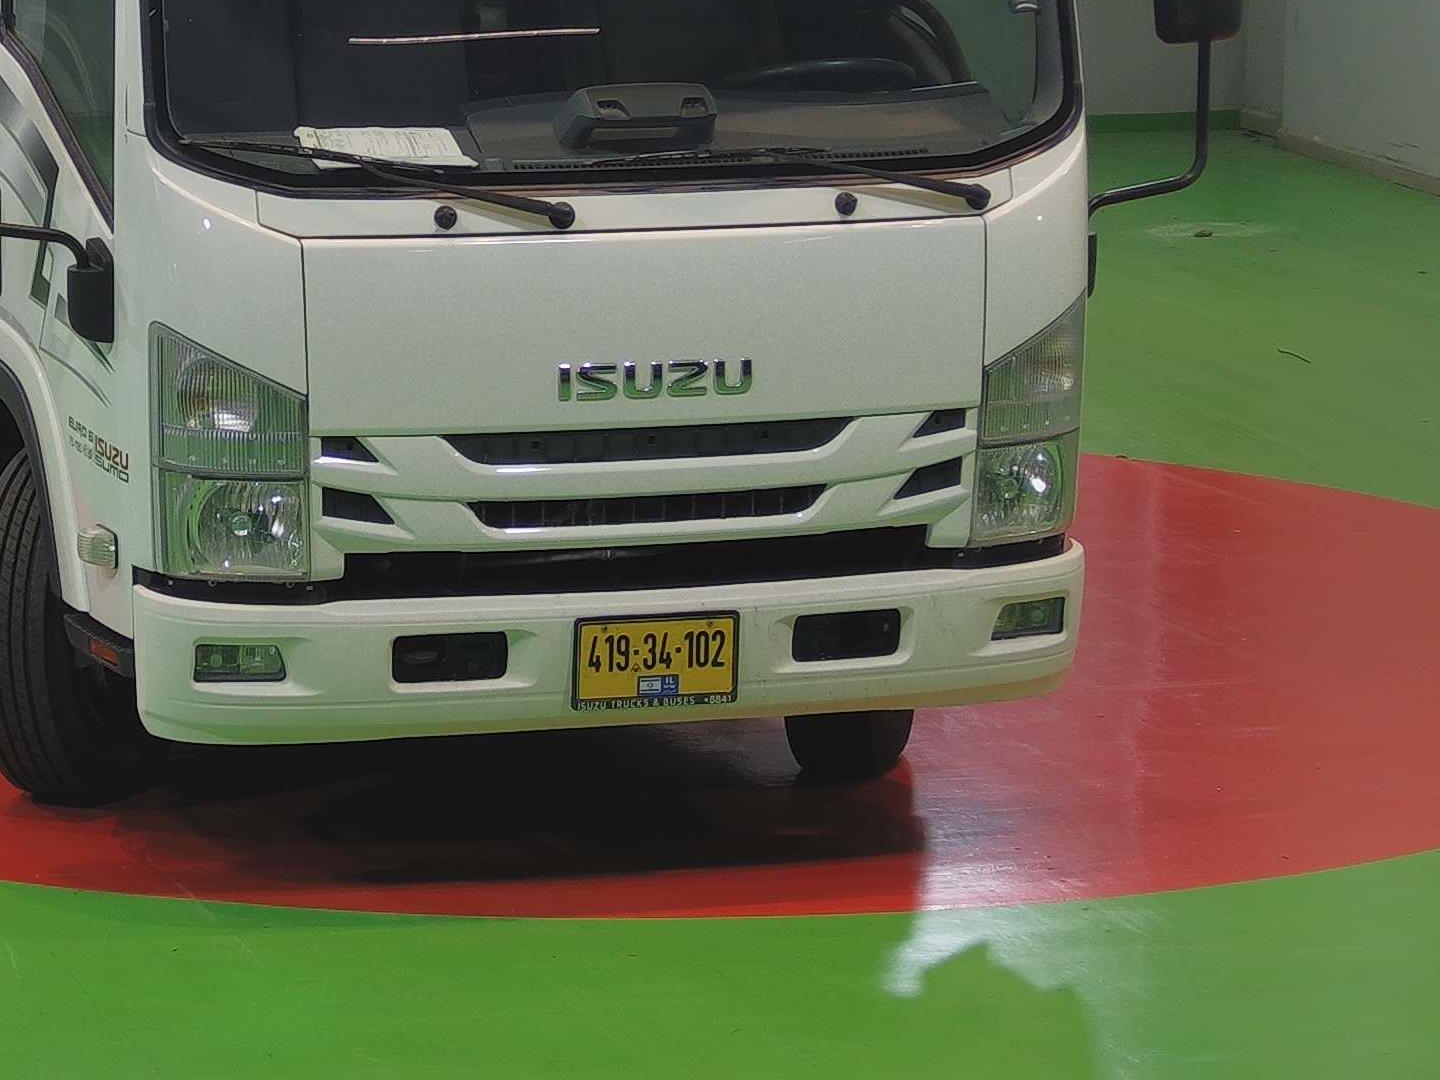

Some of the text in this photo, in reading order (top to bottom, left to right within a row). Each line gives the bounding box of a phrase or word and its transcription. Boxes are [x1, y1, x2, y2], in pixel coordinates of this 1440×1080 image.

[558, 358, 752, 401] ISUZU
[95, 435, 128, 470] ISUZU
[577, 701, 606, 712] ISUZU
[611, 698, 648, 709] TRUCKS
[663, 696, 695, 707] BUSES
